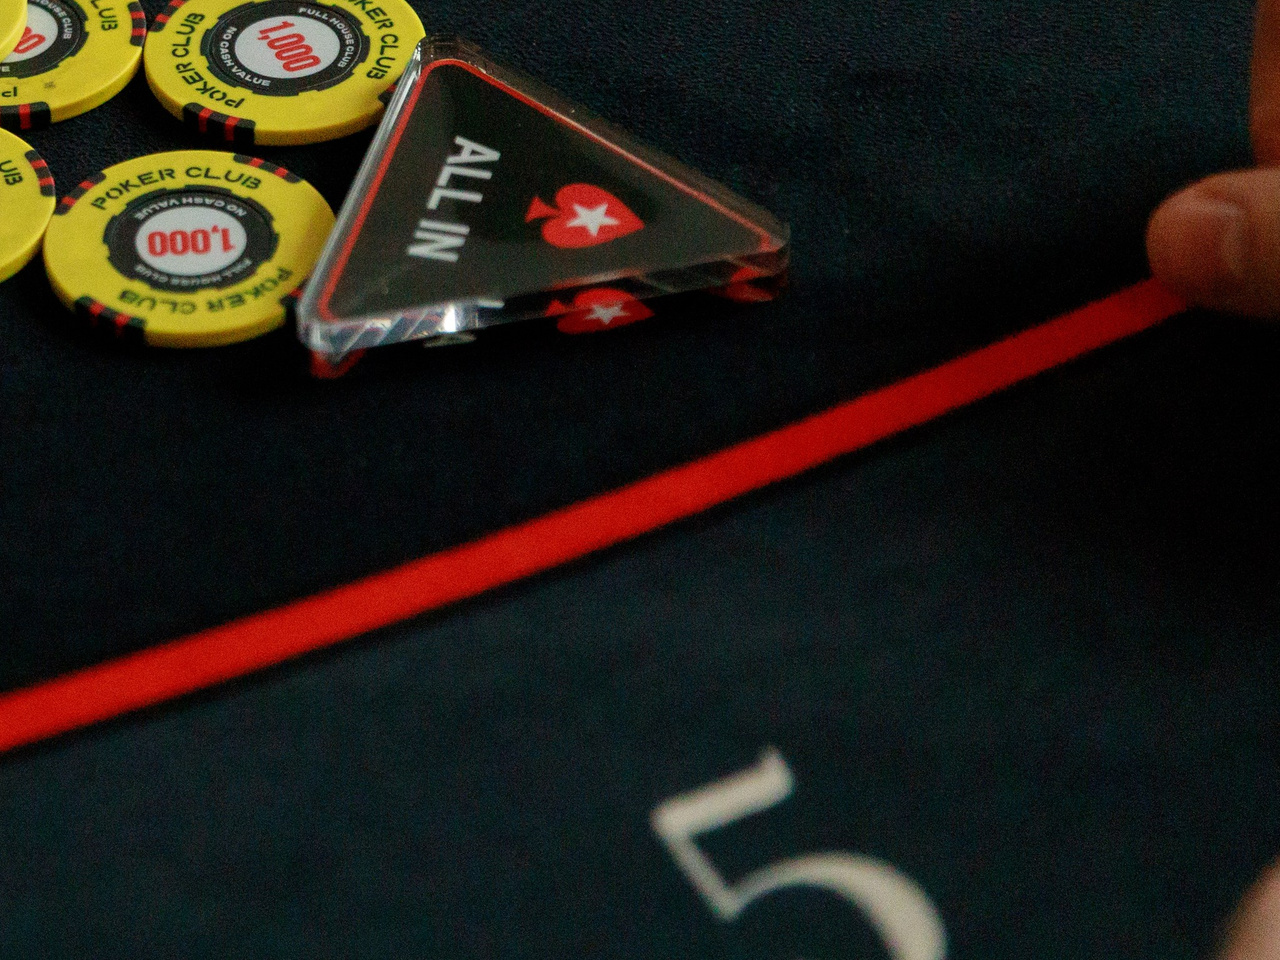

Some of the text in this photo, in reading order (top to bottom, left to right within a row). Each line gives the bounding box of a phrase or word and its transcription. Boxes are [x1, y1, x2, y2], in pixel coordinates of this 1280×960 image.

[62, 17, 73, 39] CLUB
[258, 21, 321, 72] 1,000
[298, 7, 354, 68] FULL HOUSE CLUB
[171, 12, 246, 109] POKER CLUB
[220, 26, 271, 87] NO CASH VALUE
[366, 32, 399, 80] CLUB
[90, 166, 263, 211] POKER CLUB
[134, 196, 248, 220] NO CASH VALUE
[406, 135, 501, 263] ALL IN
[147, 224, 236, 257] 1,000
[117, 266, 294, 315] POKER CLUB
[650, 745, 949, 960] 5
